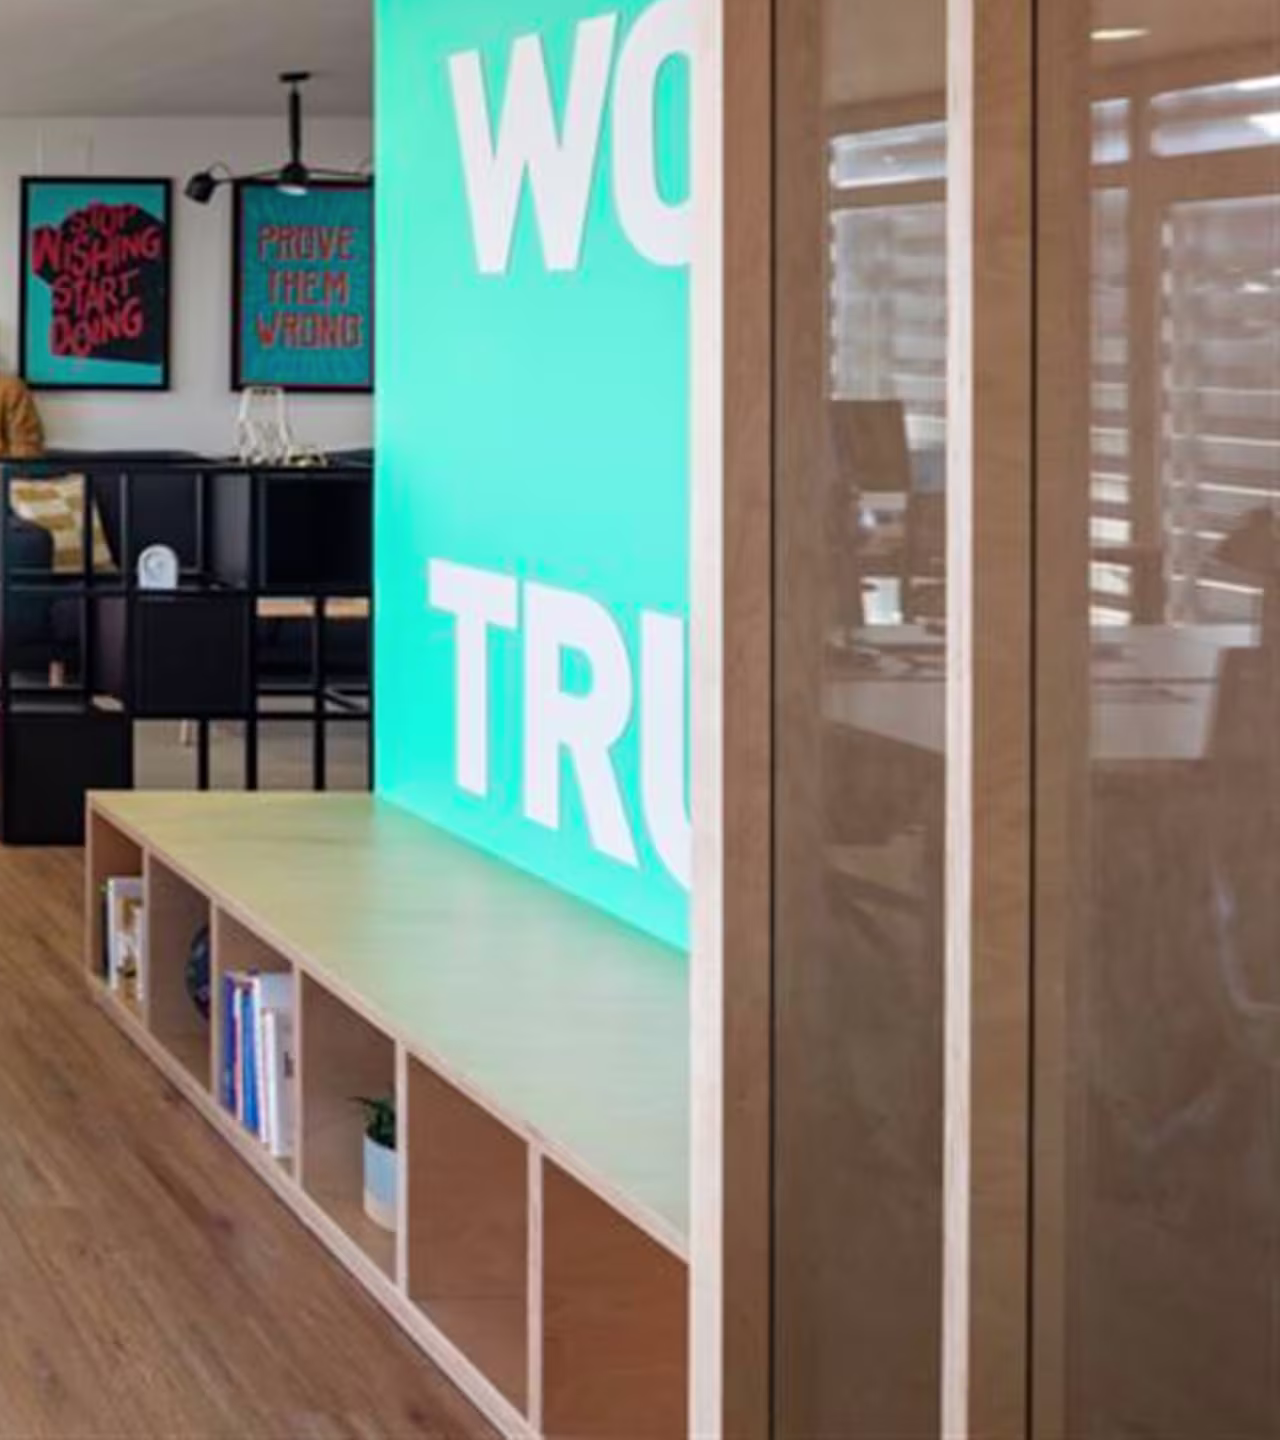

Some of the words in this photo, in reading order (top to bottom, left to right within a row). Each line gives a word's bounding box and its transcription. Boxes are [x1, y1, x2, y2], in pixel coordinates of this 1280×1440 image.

[32, 227, 161, 277] WISHING
[258, 225, 358, 261] PROVE
[53, 268, 140, 317] START
[268, 270, 349, 305] THEM
[51, 297, 144, 357] DOING
[255, 312, 363, 348] WRONG
